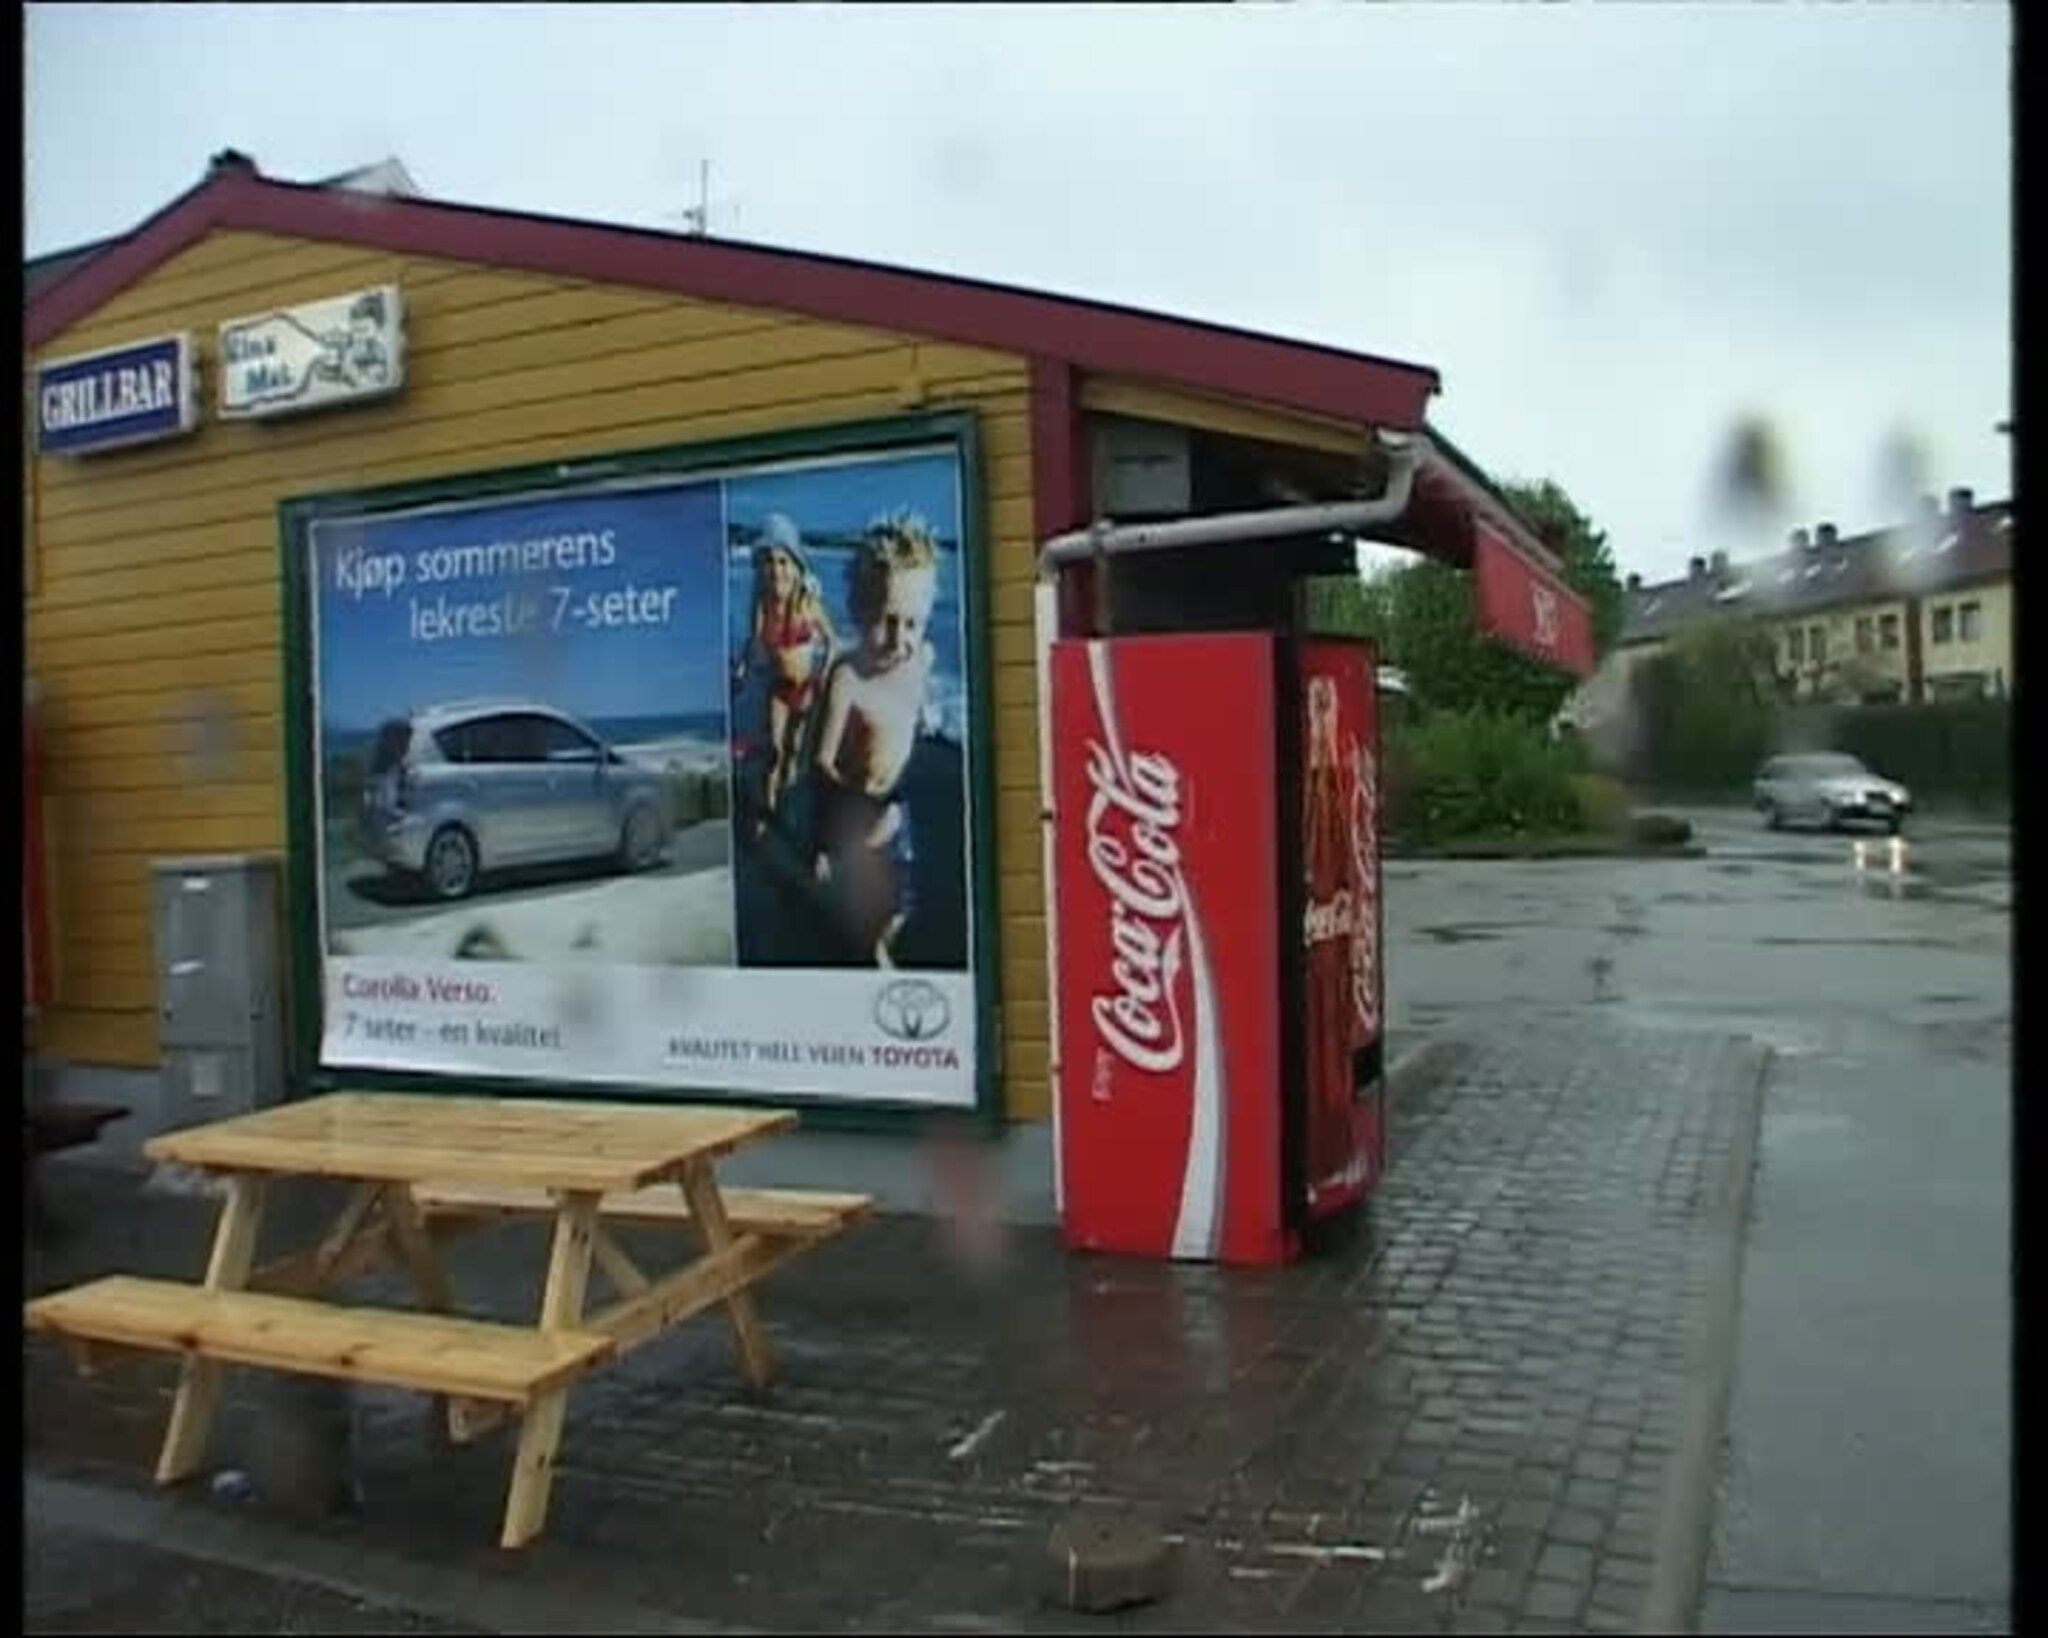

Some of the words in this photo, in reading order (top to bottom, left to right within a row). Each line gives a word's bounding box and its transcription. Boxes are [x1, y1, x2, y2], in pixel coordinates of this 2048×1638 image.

[42, 357, 174, 431] GRILLBAR
[335, 547, 405, 598] Kjøp
[416, 529, 616, 583] sommerens
[549, 585, 678, 630] 7-seter
[1085, 736, 1184, 1073] Coca-Cola
[872, 1044, 960, 1072] TOYOTA
